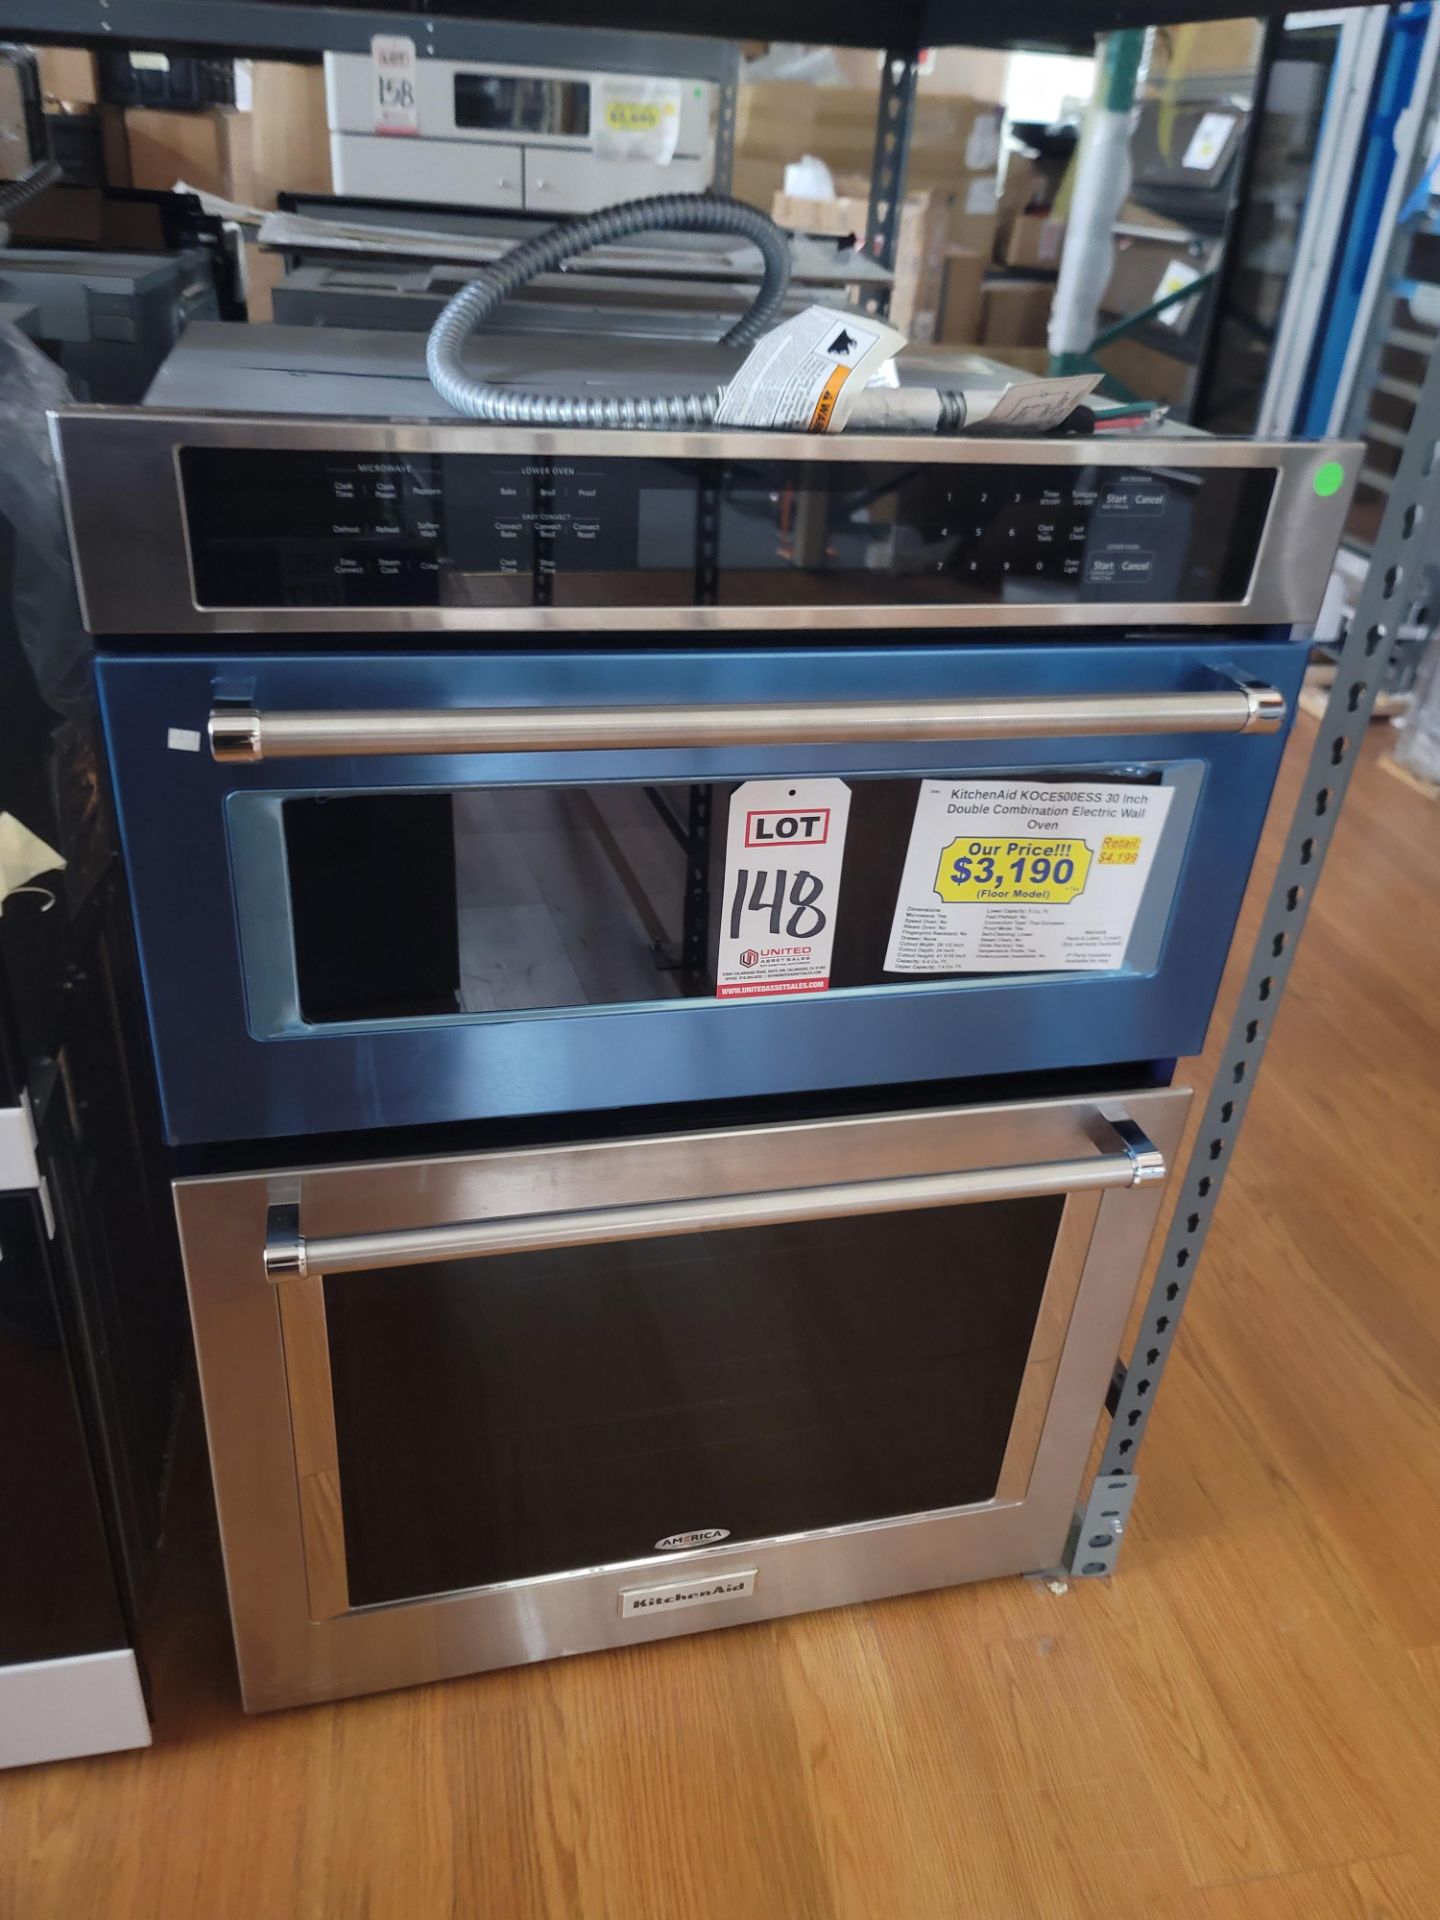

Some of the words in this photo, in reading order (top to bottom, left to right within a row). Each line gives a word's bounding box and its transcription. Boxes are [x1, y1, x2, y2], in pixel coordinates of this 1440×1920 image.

[521, 466, 549, 475] LOWER
[552, 467, 575, 475] OVEN
[500, 487, 517, 496] Bake
[540, 488, 556, 496] Broil
[578, 489, 596, 497] Proof
[1106, 494, 1128, 504] Start
[1135, 494, 1163, 505] Cancel
[1093, 561, 1115, 571] Start
[1121, 561, 1150, 571] Cancel
[951, 789, 1017, 800] KitchenAid
[1020, 790, 1102, 803] KOCE500ESS
[1105, 793, 1120, 804] 30
[1123, 794, 1148, 805] Inch
[947, 804, 990, 814] Double
[993, 804, 1068, 816] Combination
[1072, 806, 1117, 818] Electric
[1121, 808, 1145, 819] Wall
[755, 815, 821, 840] LOT
[1027, 819, 1059, 830] Oven
[968, 842, 1002, 856] Our
[1006, 842, 1072, 857] Price!!!
[950, 856, 1074, 889] $3,190
[977, 889, 1009, 899] (Floor
[1012, 889, 1050, 899] Model)
[730, 869, 827, 939] 148
[760, 946, 812, 957] UNITED
[721, 981, 824, 995] WWW.UNITEDASSETSALES.COM
[661, 1530, 722, 1547] AMERICA
[633, 1582, 745, 1609] KitchenAid
